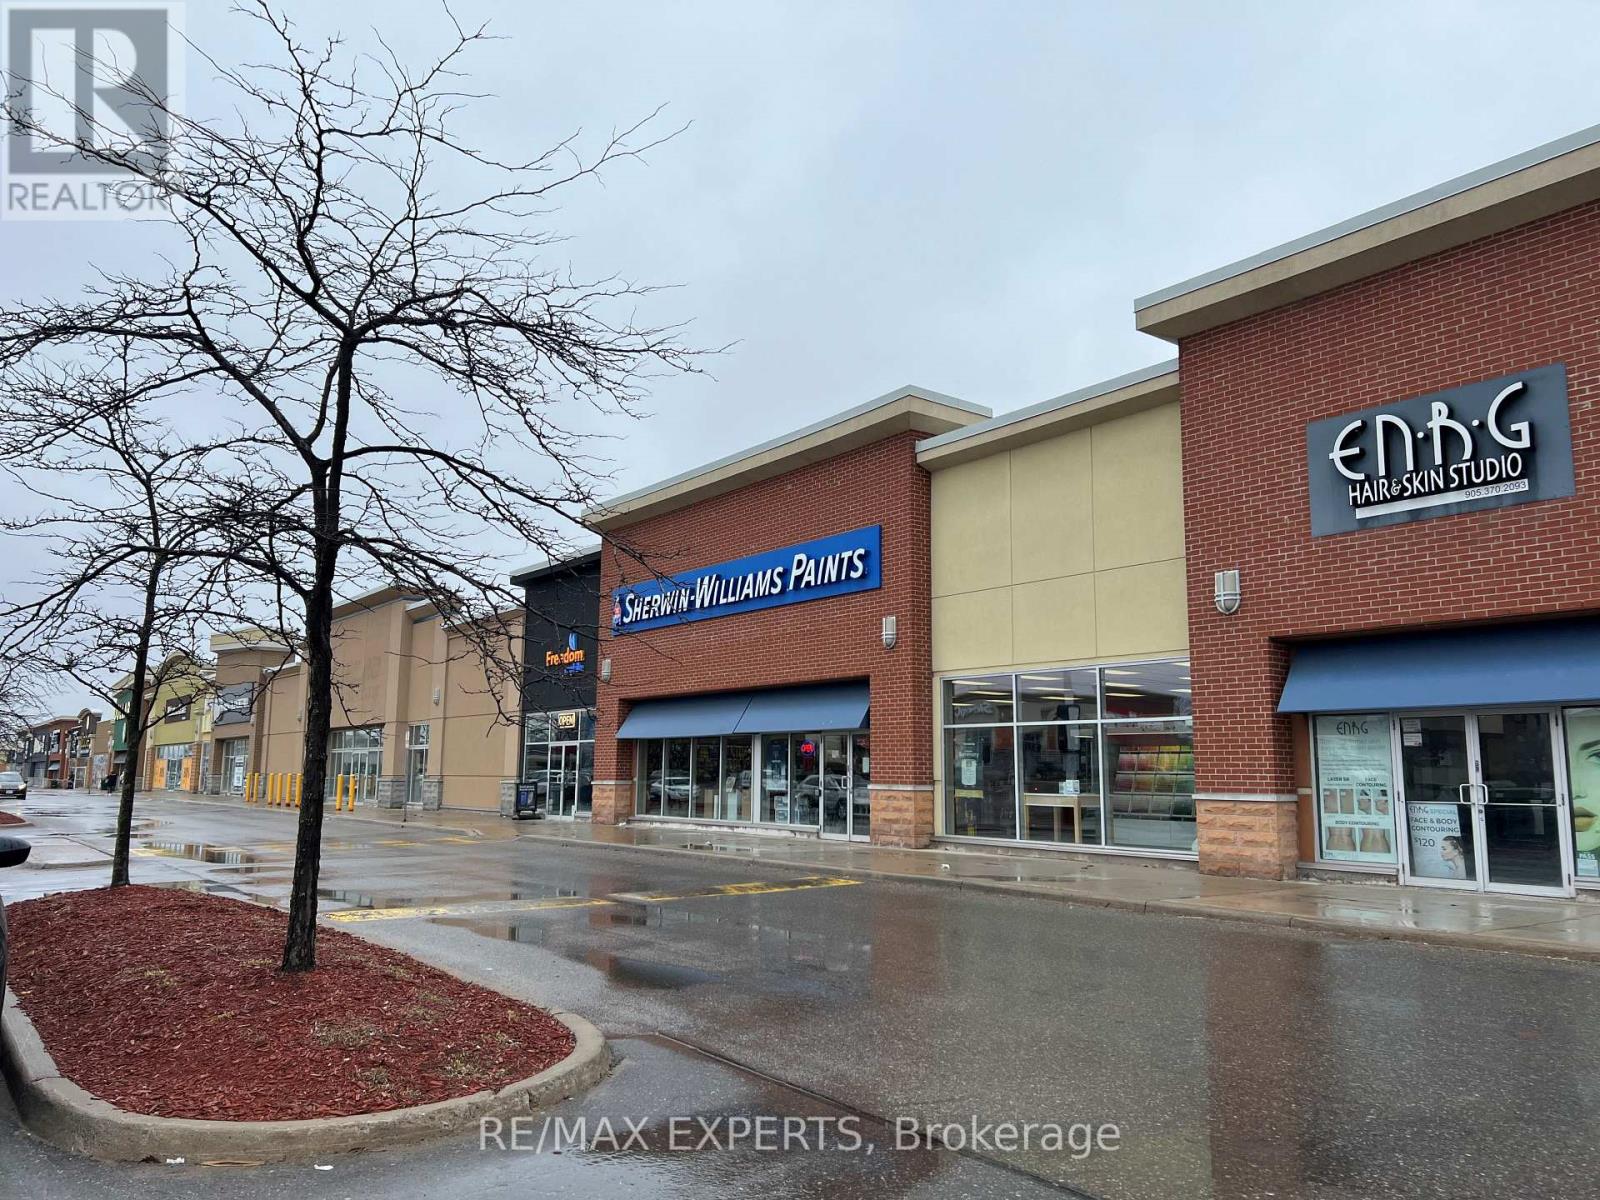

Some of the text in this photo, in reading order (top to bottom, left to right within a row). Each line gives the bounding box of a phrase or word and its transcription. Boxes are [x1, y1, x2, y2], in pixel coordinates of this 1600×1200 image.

[1403, 467, 1444, 497] SKIN
[1450, 452, 1523, 488] STUDIO
[1465, 481, 1527, 499] 905.370.2093
[623, 566, 784, 624] SHERWIN-WILLIAMS
[788, 548, 866, 591] PAINTS
[559, 714, 575, 726] OPEN
[1411, 825, 1460, 833] CONTOURING
